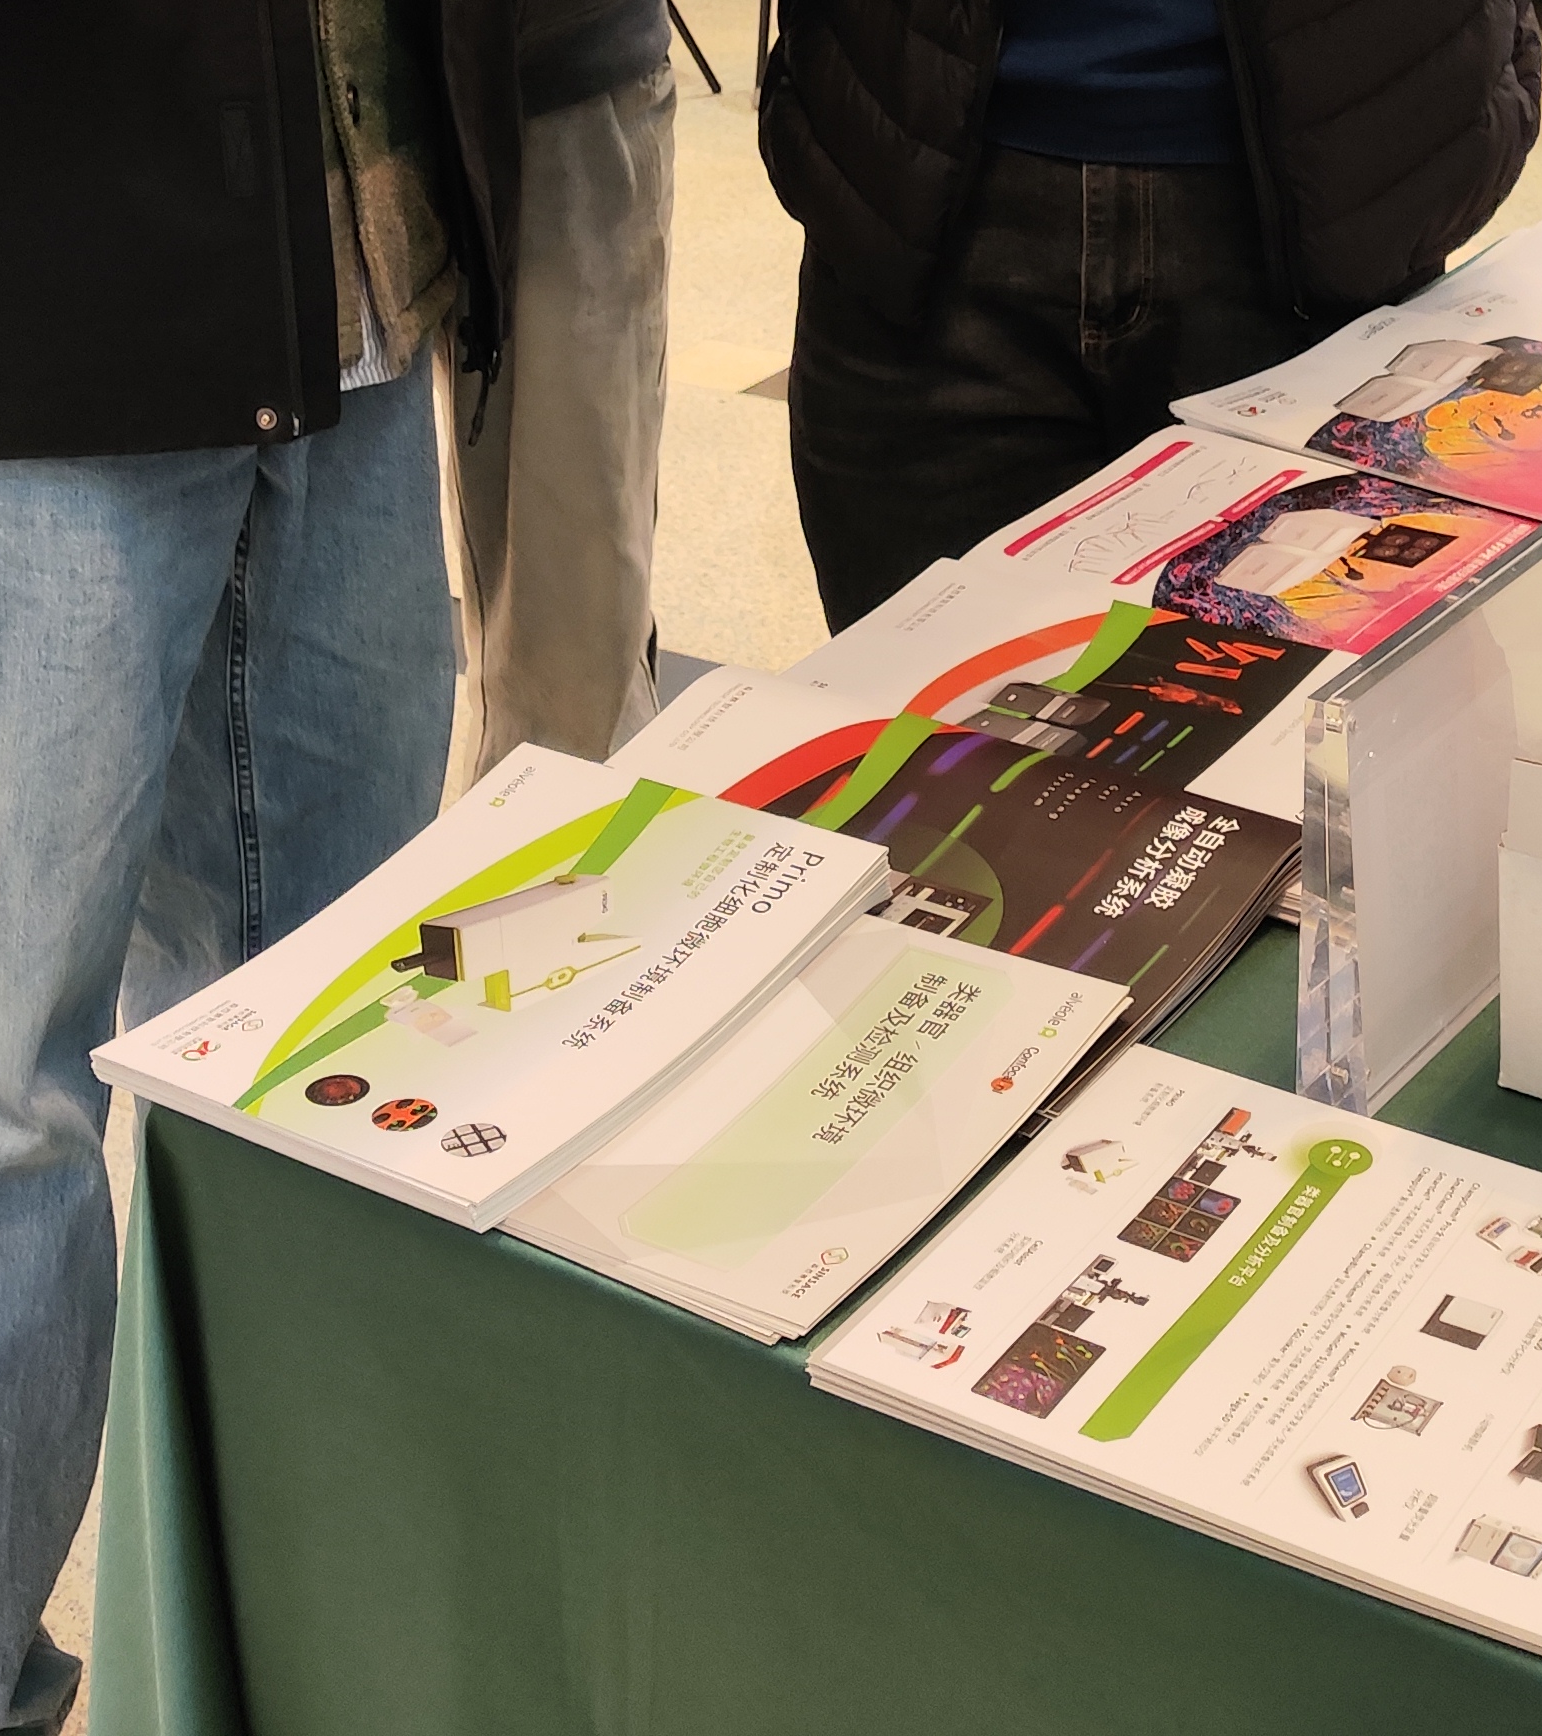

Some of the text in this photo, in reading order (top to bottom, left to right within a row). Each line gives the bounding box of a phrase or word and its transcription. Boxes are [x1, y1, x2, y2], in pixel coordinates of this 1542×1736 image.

[495, 765, 542, 797] alvéole
[1027, 770, 1075, 807] System
[1041, 776, 1099, 820] Imaging
[1096, 783, 1120, 800] Gel
[1111, 790, 1143, 814] Auto
[745, 851, 828, 916] Primo
[1089, 804, 1211, 919] 成像分析系统
[1141, 814, 1245, 910] 全自动凝胶
[559, 842, 797, 1051] 定制化细胞微环境制备系统
[1045, 991, 1085, 1027] alvéole
[806, 972, 951, 1101] 制备及检测系统
[1224, 1184, 1324, 1287] 类器官制备及分析平台
[789, 1266, 830, 1299] SINSAGE
